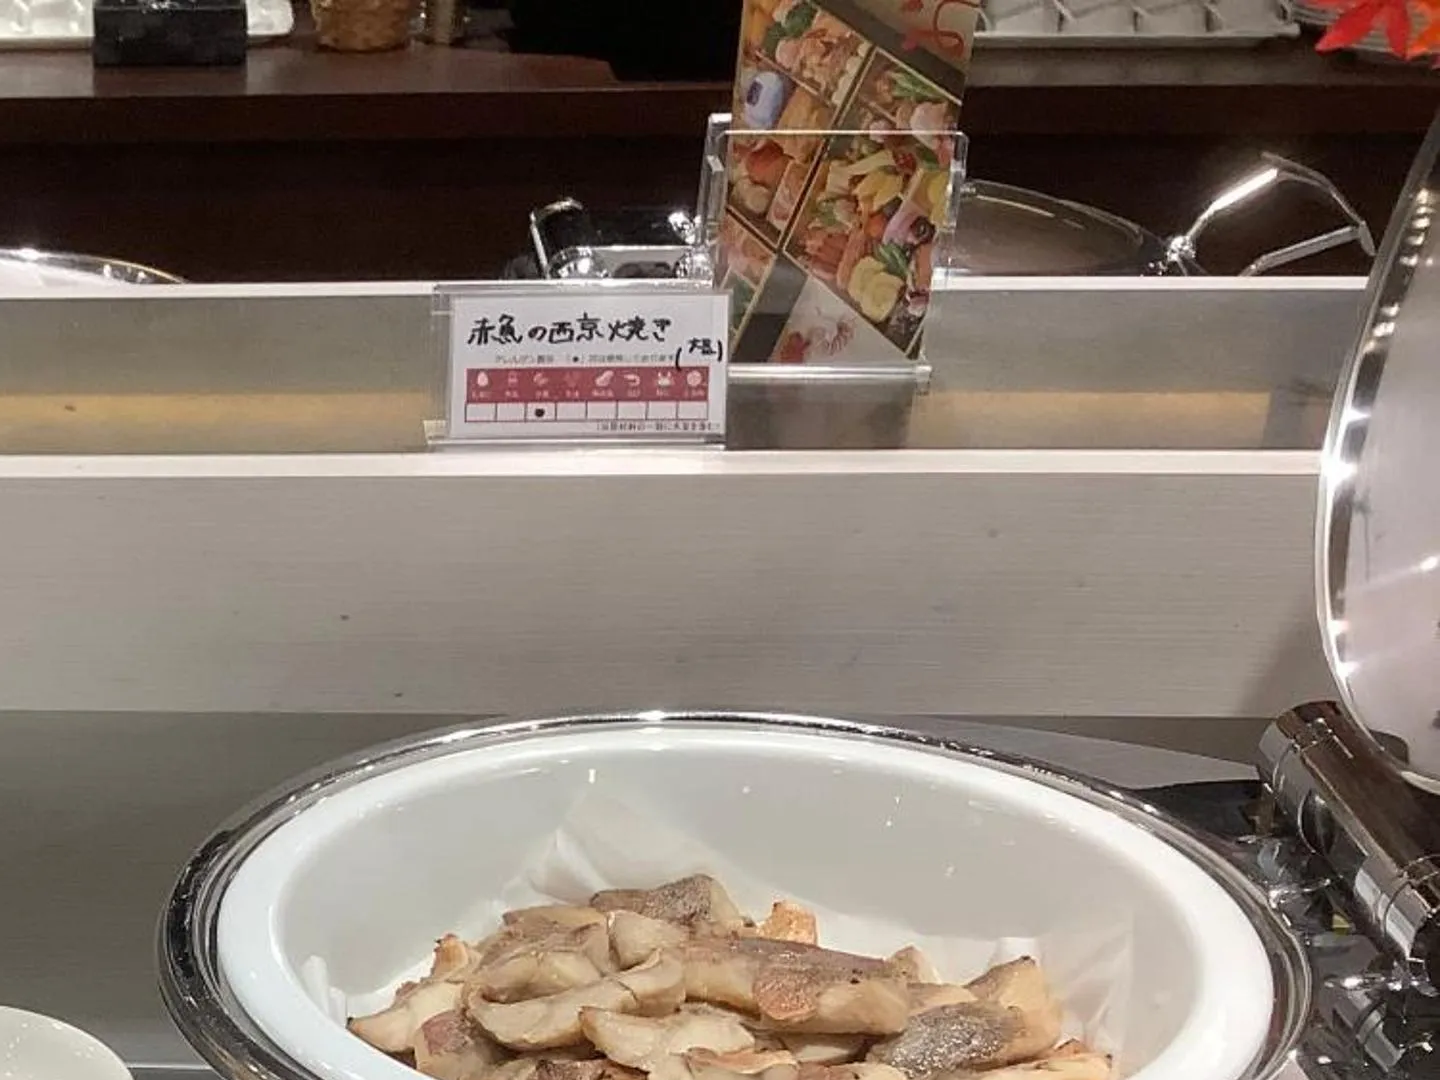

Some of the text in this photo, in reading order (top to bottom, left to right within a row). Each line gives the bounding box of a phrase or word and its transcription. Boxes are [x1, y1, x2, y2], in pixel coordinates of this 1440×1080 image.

[467, 312, 671, 346] 赤魚の西京焼き
